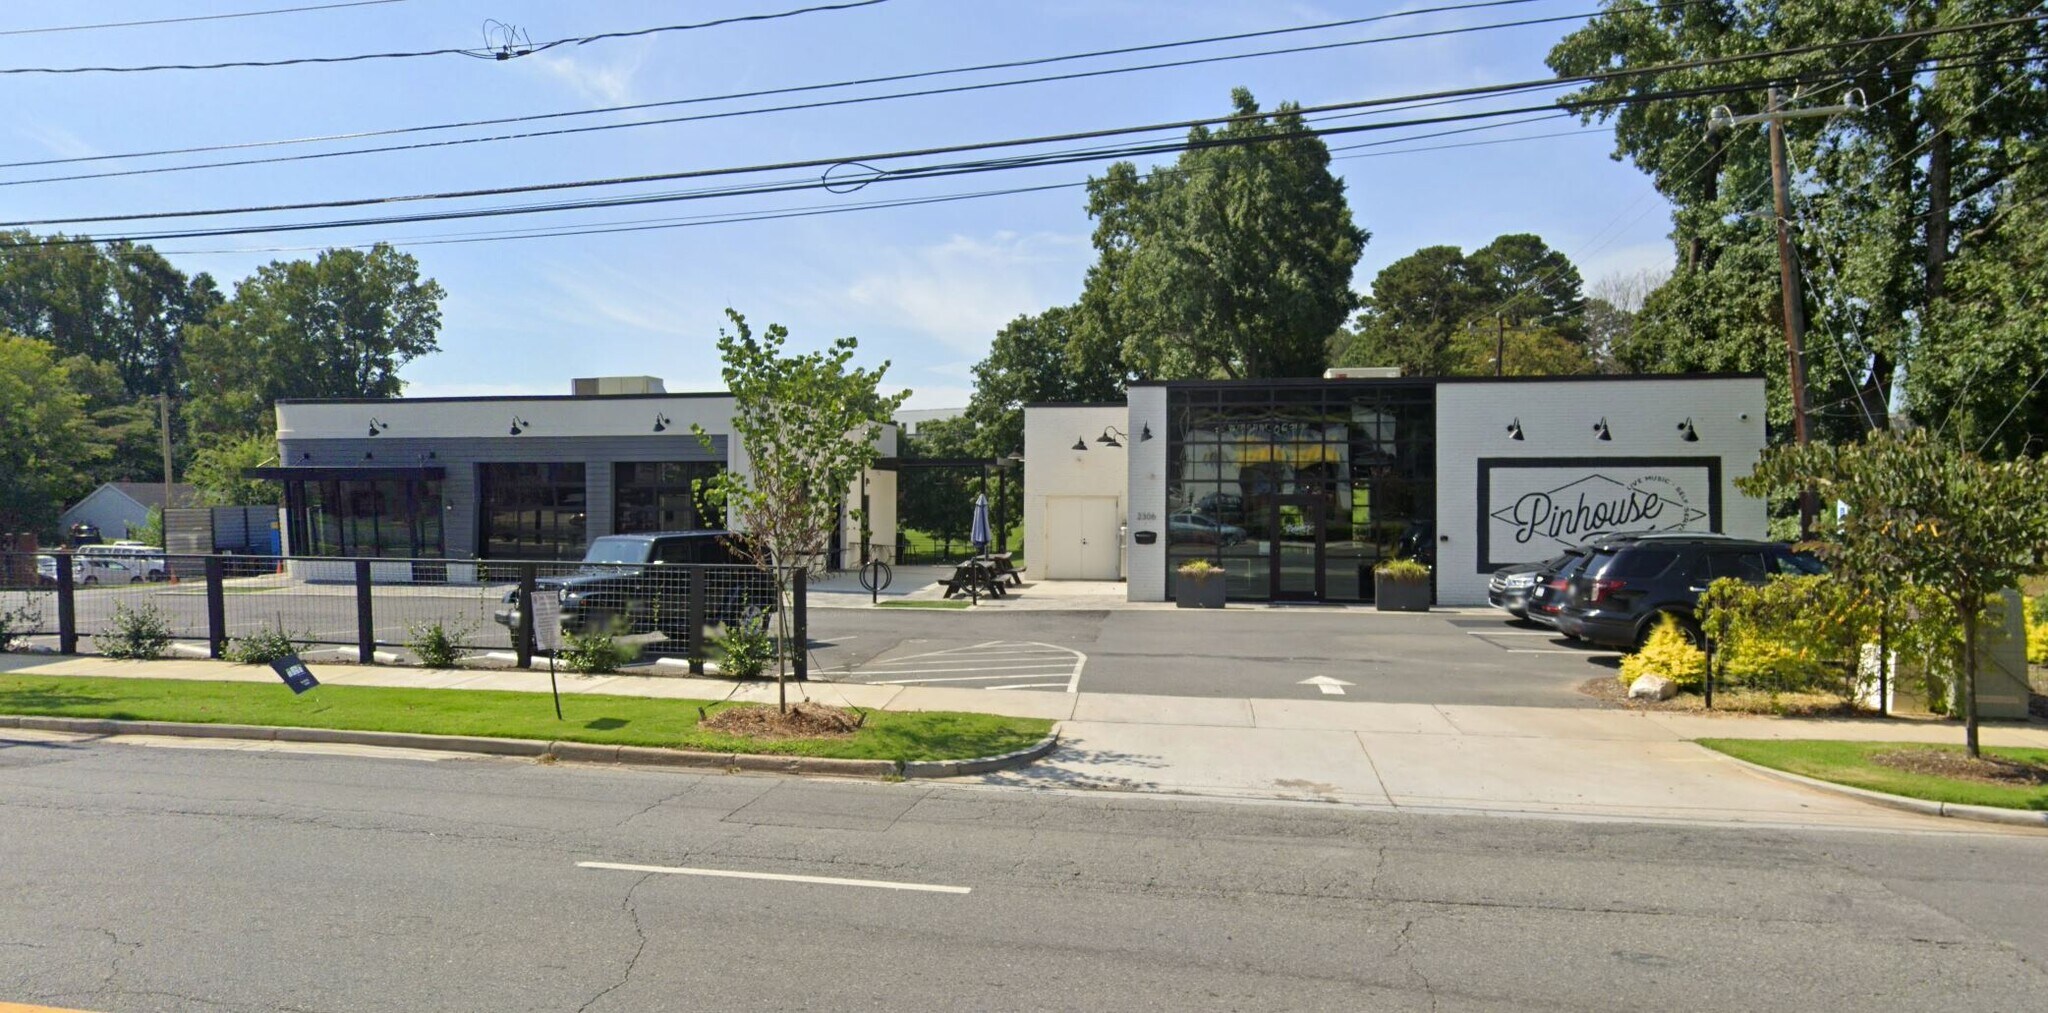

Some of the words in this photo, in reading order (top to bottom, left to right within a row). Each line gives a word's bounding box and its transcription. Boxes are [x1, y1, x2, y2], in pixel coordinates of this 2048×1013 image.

[1626, 477, 1642, 491] LIVE
[1644, 475, 1671, 485] MUSIC
[1675, 486, 1689, 504] SELF
[1513, 491, 1664, 543] Pinhouse
